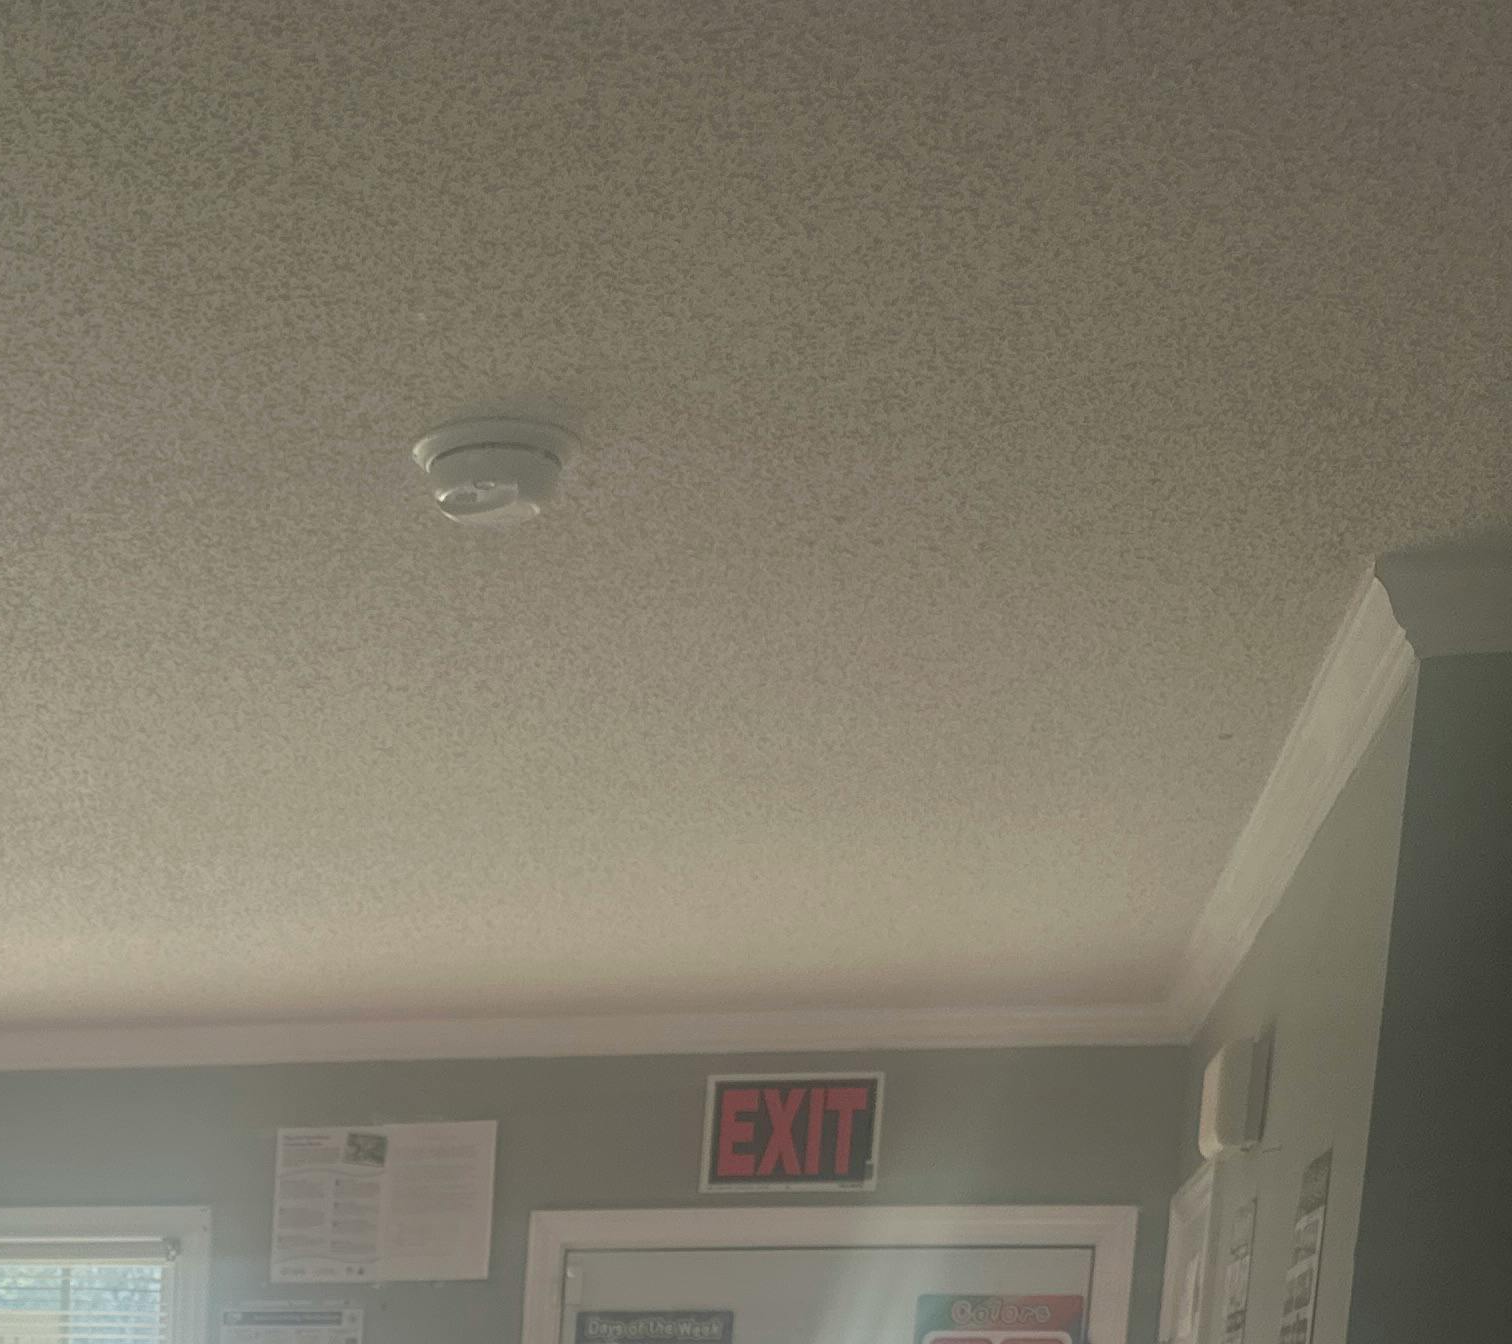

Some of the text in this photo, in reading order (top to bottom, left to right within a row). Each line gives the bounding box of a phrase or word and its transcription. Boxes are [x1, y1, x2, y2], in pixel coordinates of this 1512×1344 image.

[717, 1088, 868, 1177] EXIT
[952, 1300, 1051, 1324] Colors
[587, 1318, 720, 1337] Days of the Week
